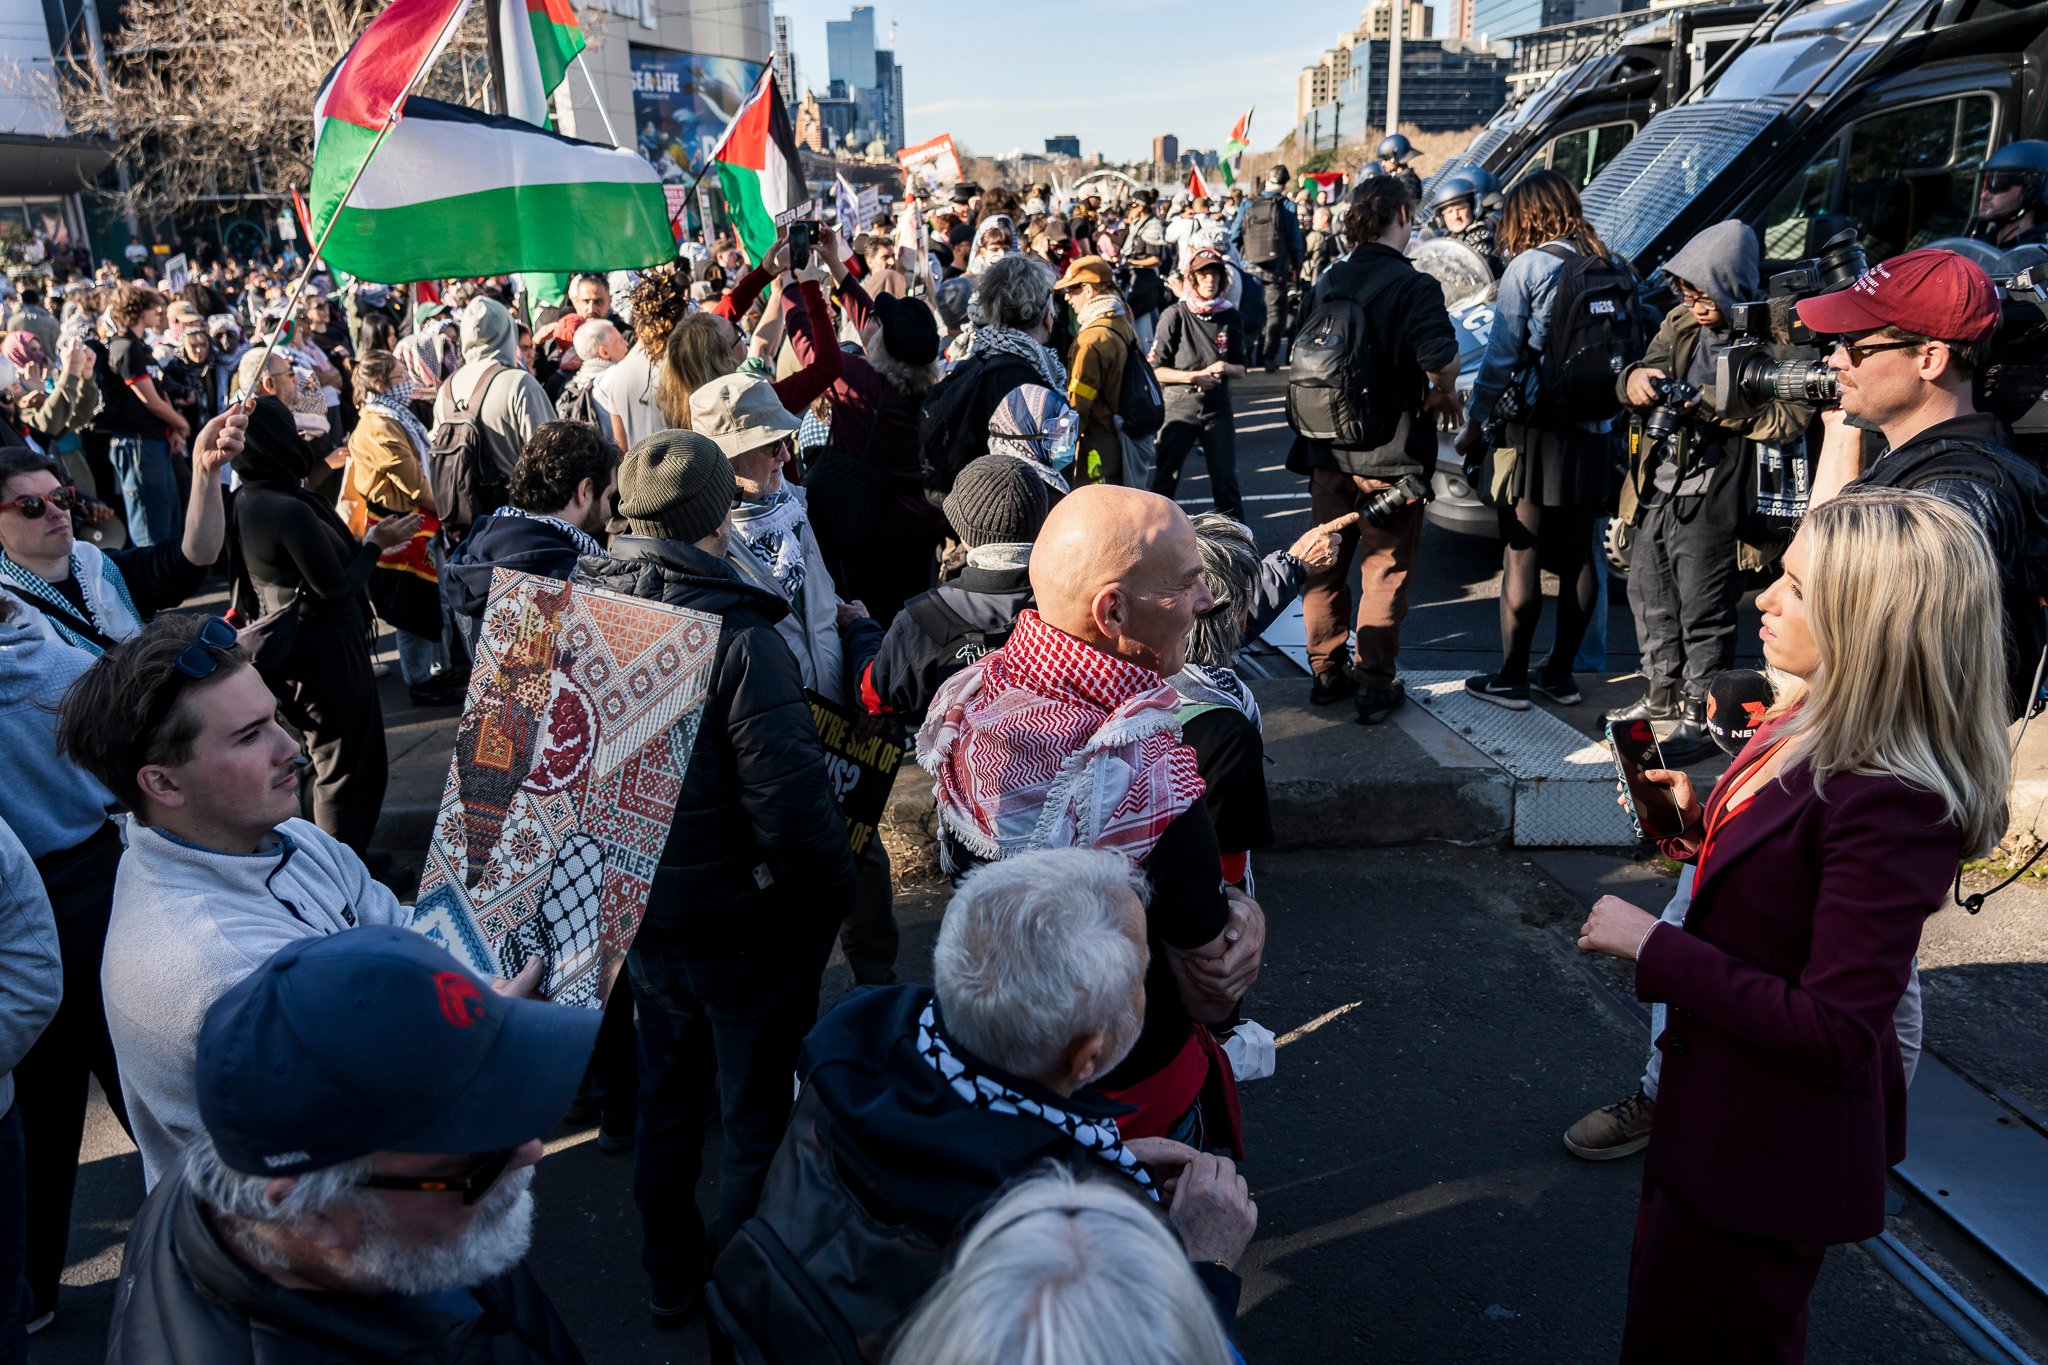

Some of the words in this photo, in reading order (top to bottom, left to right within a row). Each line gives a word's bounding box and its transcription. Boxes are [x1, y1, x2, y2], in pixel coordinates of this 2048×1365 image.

[776, 208, 796, 228] NEVER
[1589, 300, 1615, 314] PRESS
[1756, 506, 1805, 517] PHOTOBOOT
[878, 742, 901, 775] OF
[851, 822, 873, 854] OF
